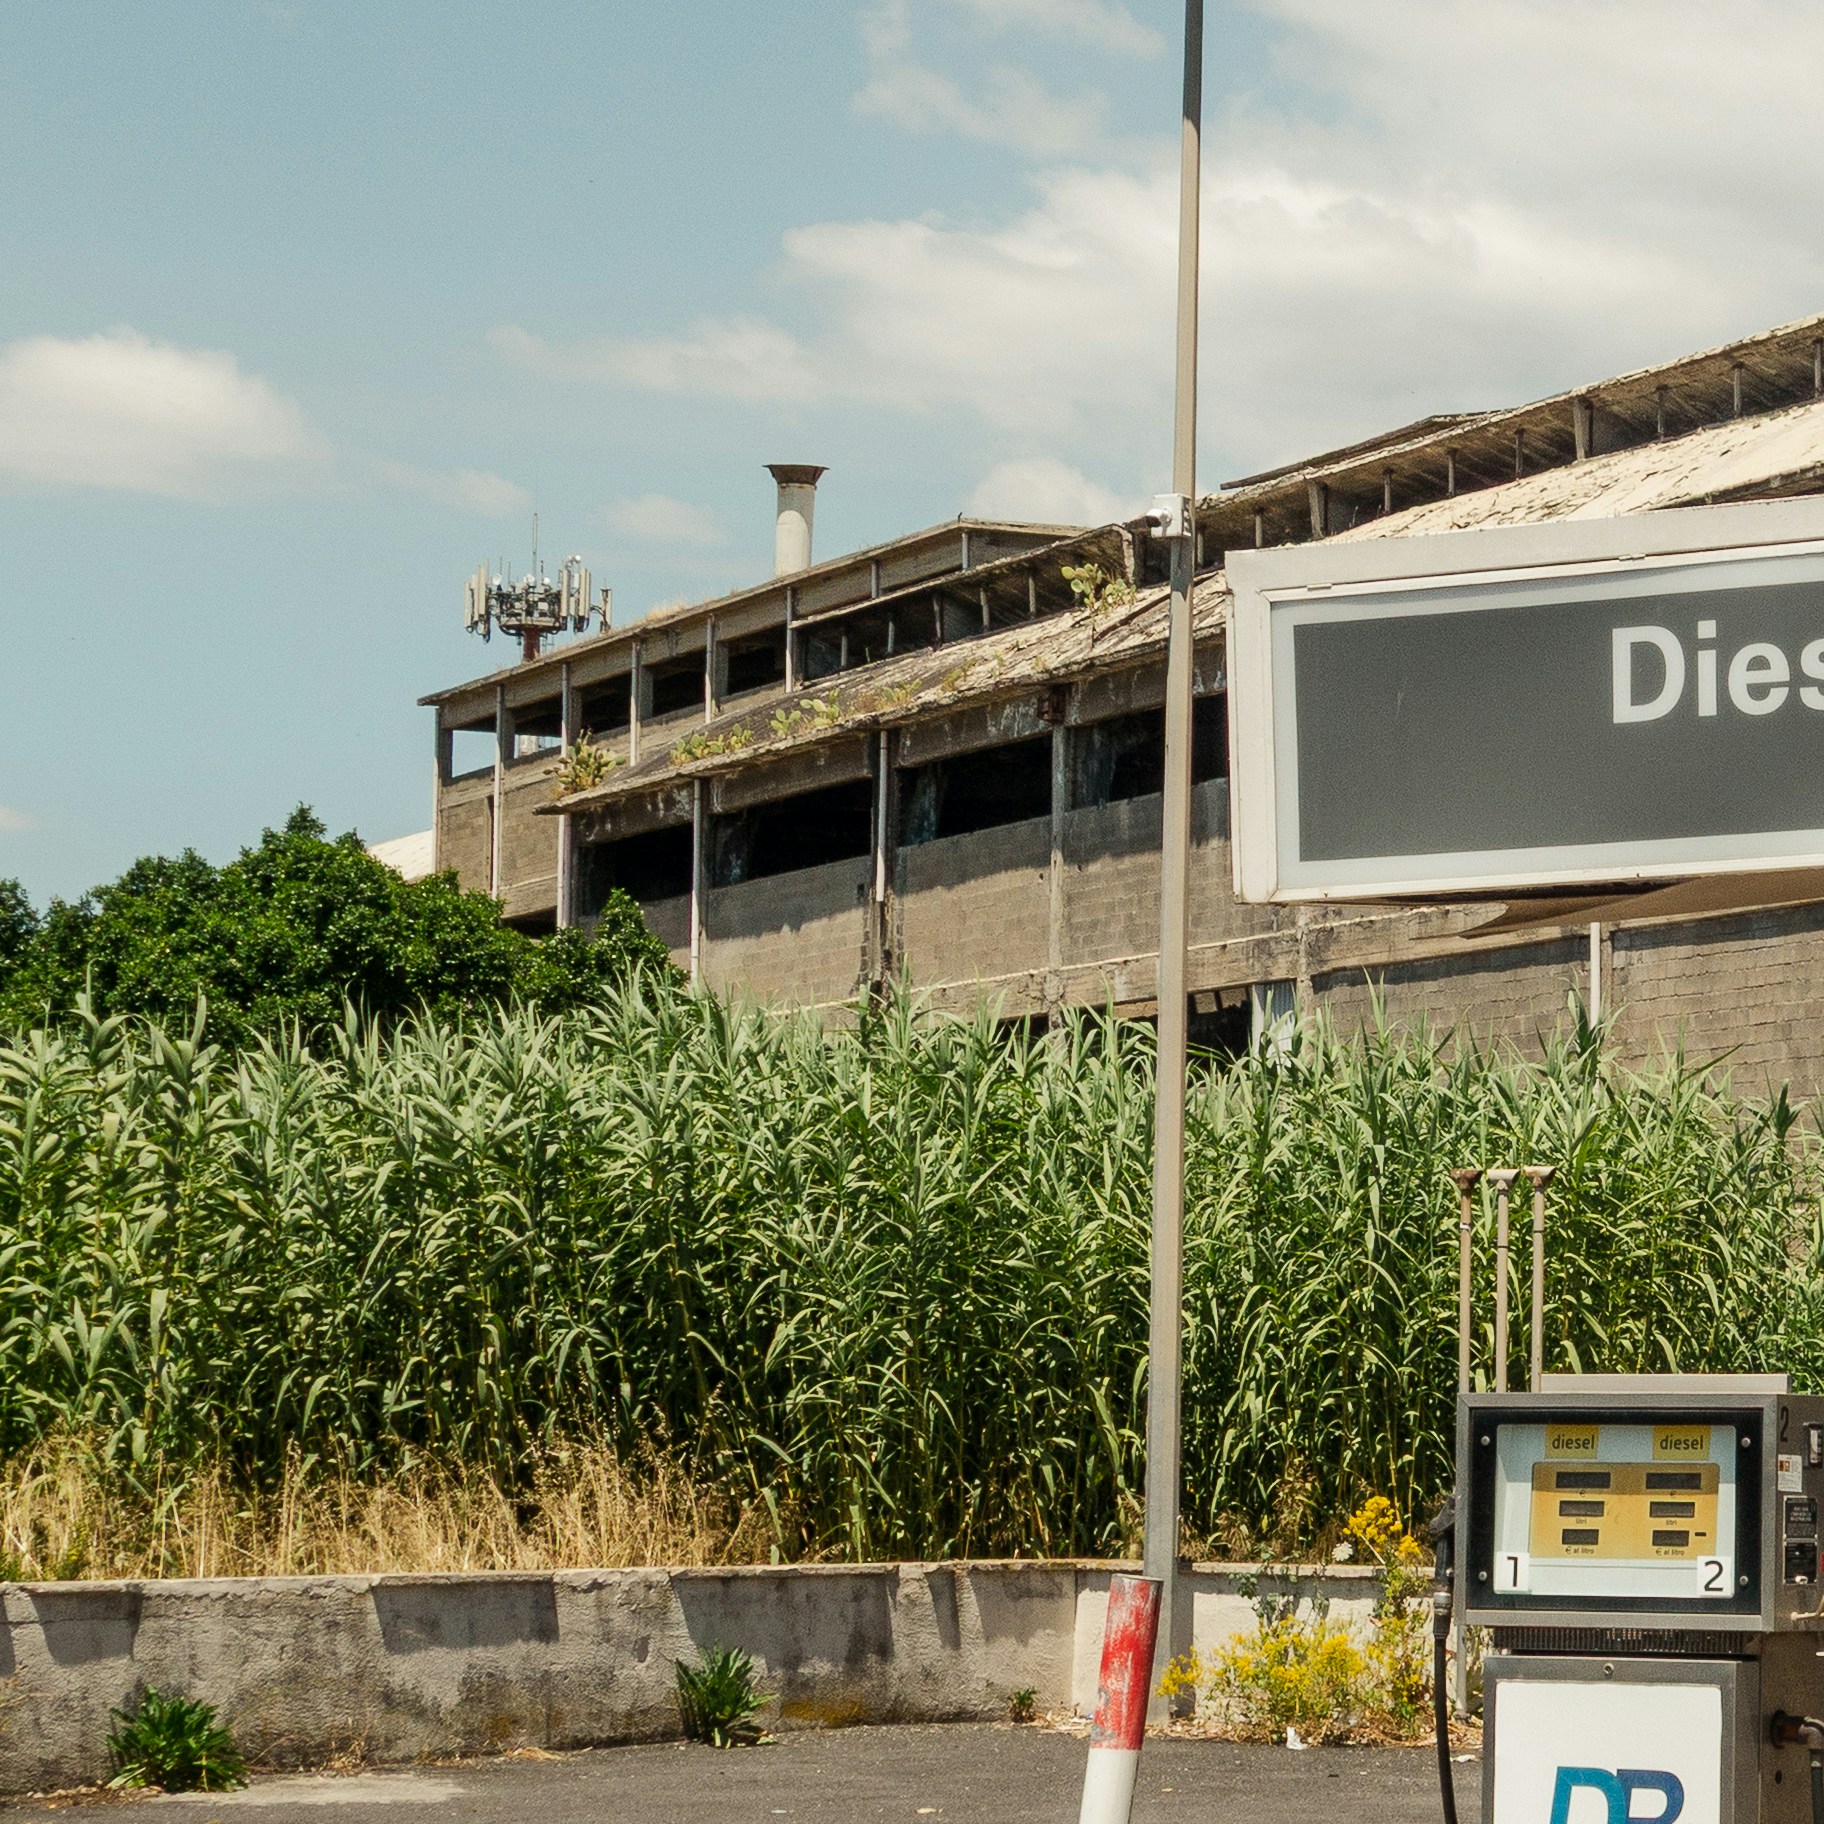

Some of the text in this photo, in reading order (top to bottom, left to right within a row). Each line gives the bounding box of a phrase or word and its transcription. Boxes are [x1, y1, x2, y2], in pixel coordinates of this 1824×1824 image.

[1780, 1406, 1789, 1443] 2
[1552, 1434, 1595, 1450] diesel
[1660, 1434, 1704, 1451] diesel
[1671, 1548, 1685, 1556] litro
[1506, 1556, 1519, 1588] 1
[1704, 1560, 1725, 1592] 2
